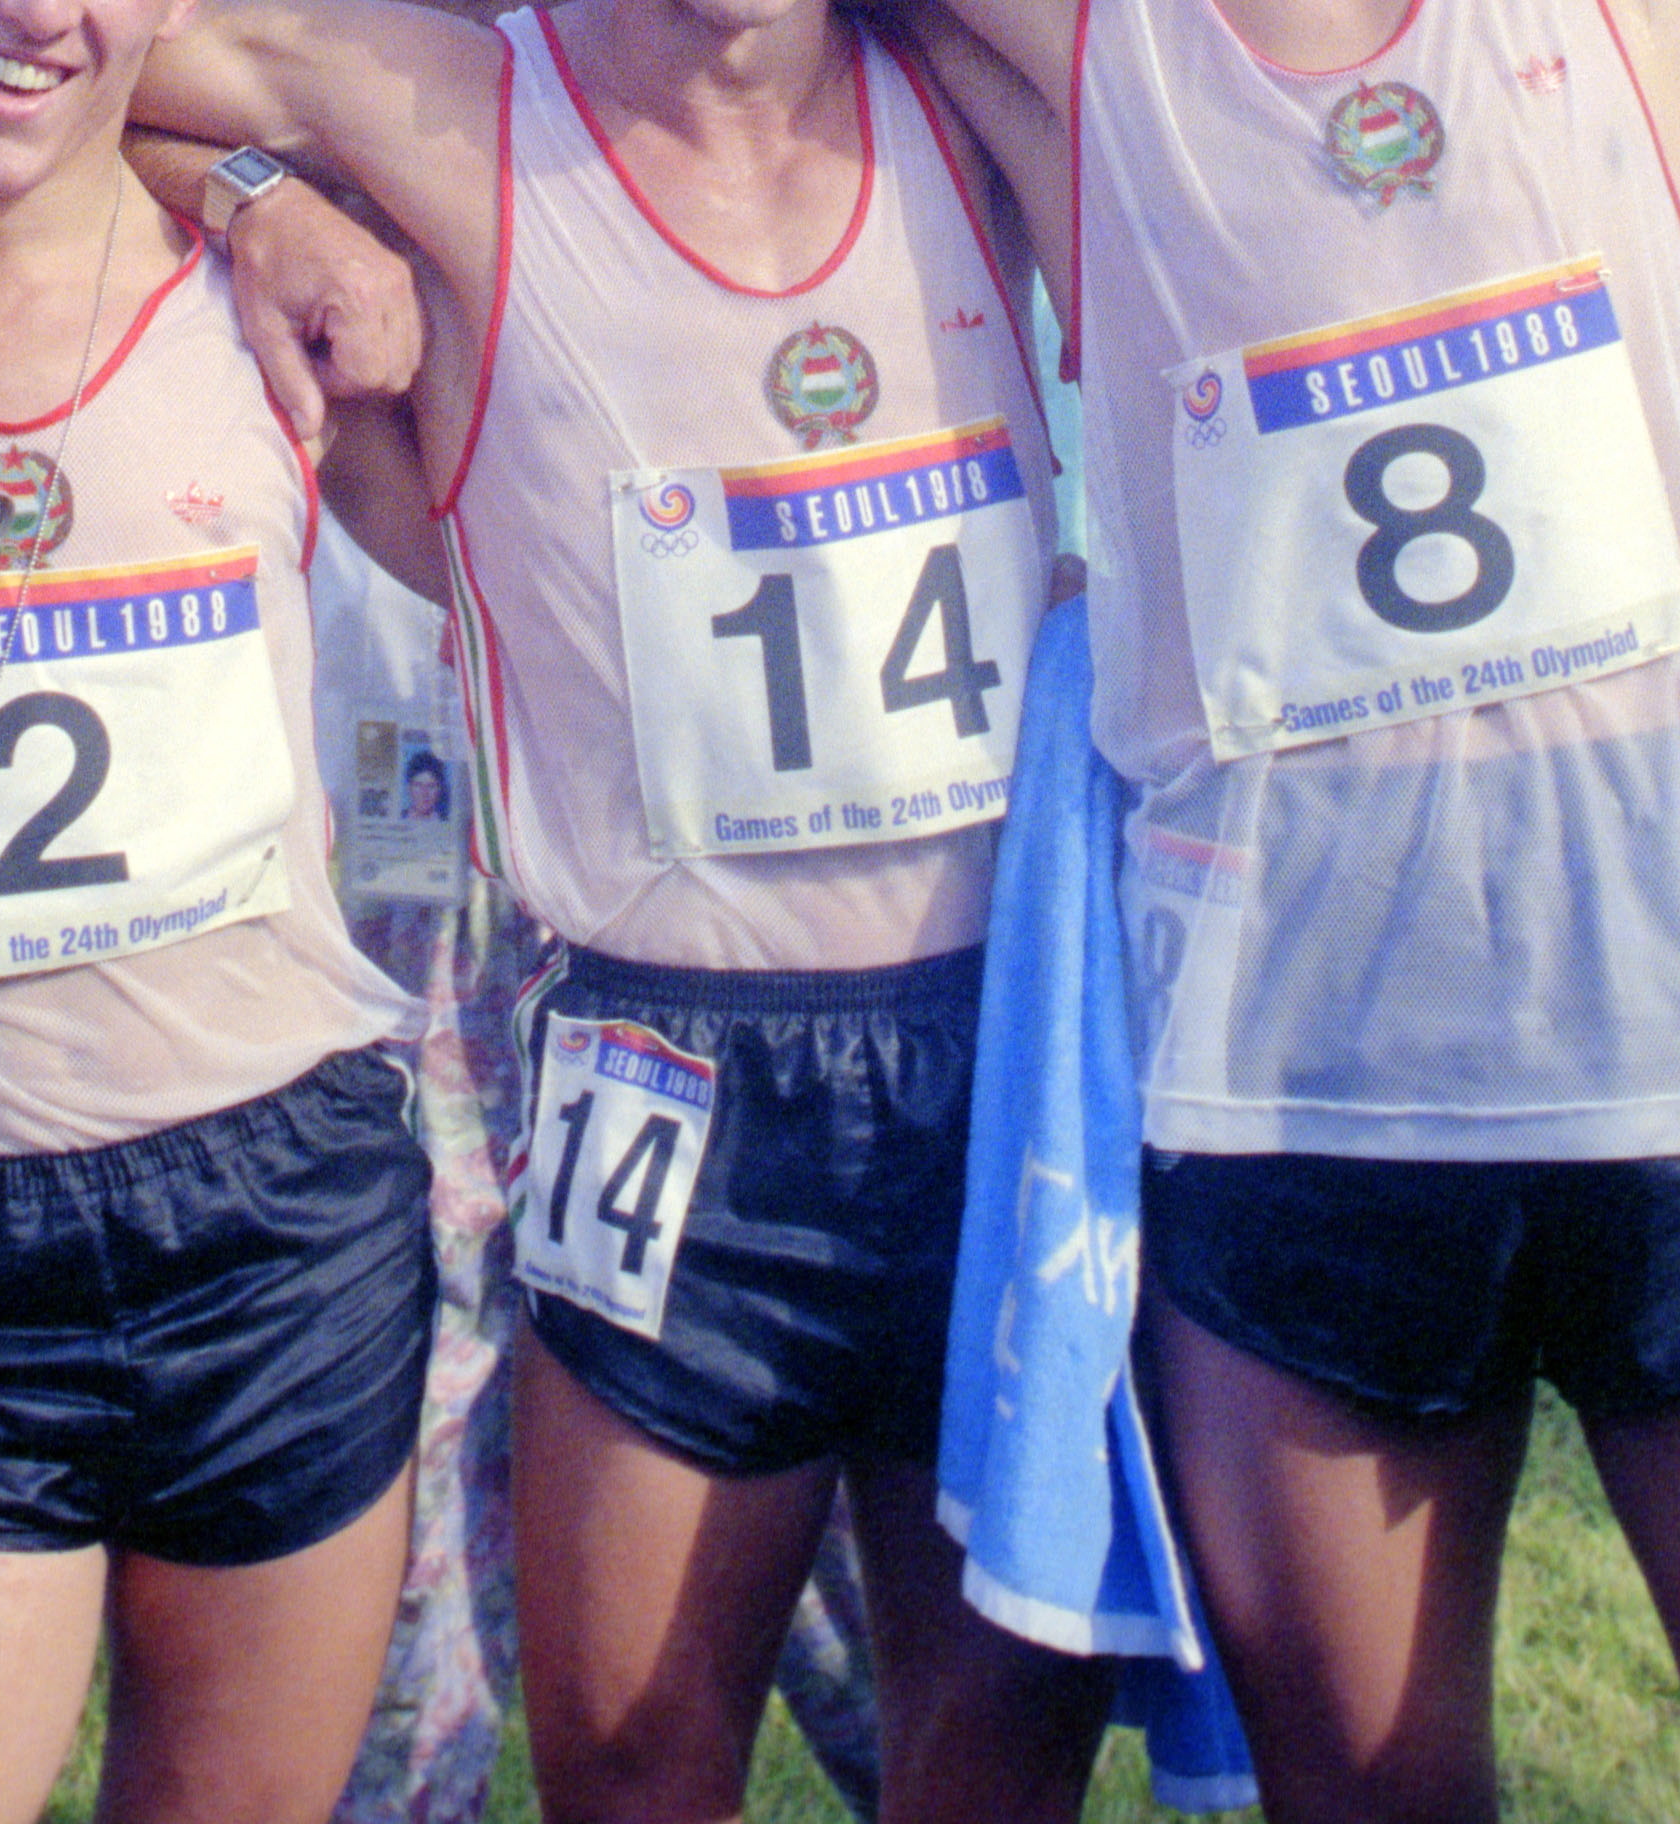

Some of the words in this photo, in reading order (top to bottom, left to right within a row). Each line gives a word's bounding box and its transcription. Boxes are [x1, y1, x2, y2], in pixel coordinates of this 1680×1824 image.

[1342, 422, 1516, 634] 8
[711, 542, 1002, 772] 14
[1280, 692, 1370, 733] Games
[1375, 681, 1403, 716] of
[1410, 672, 1455, 706] the
[1461, 656, 1524, 694] 24th
[1530, 622, 1640, 681] Olympiad
[714, 812, 799, 843] Games
[808, 805, 833, 833] of
[842, 802, 882, 831] the
[890, 788, 942, 826] 24th
[7, 931, 51, 962] the
[60, 922, 119, 957] 24th
[128, 888, 228, 943] Olympiad
[604, 1047, 662, 1090] SEOUL
[547, 1089, 682, 1276] 14
